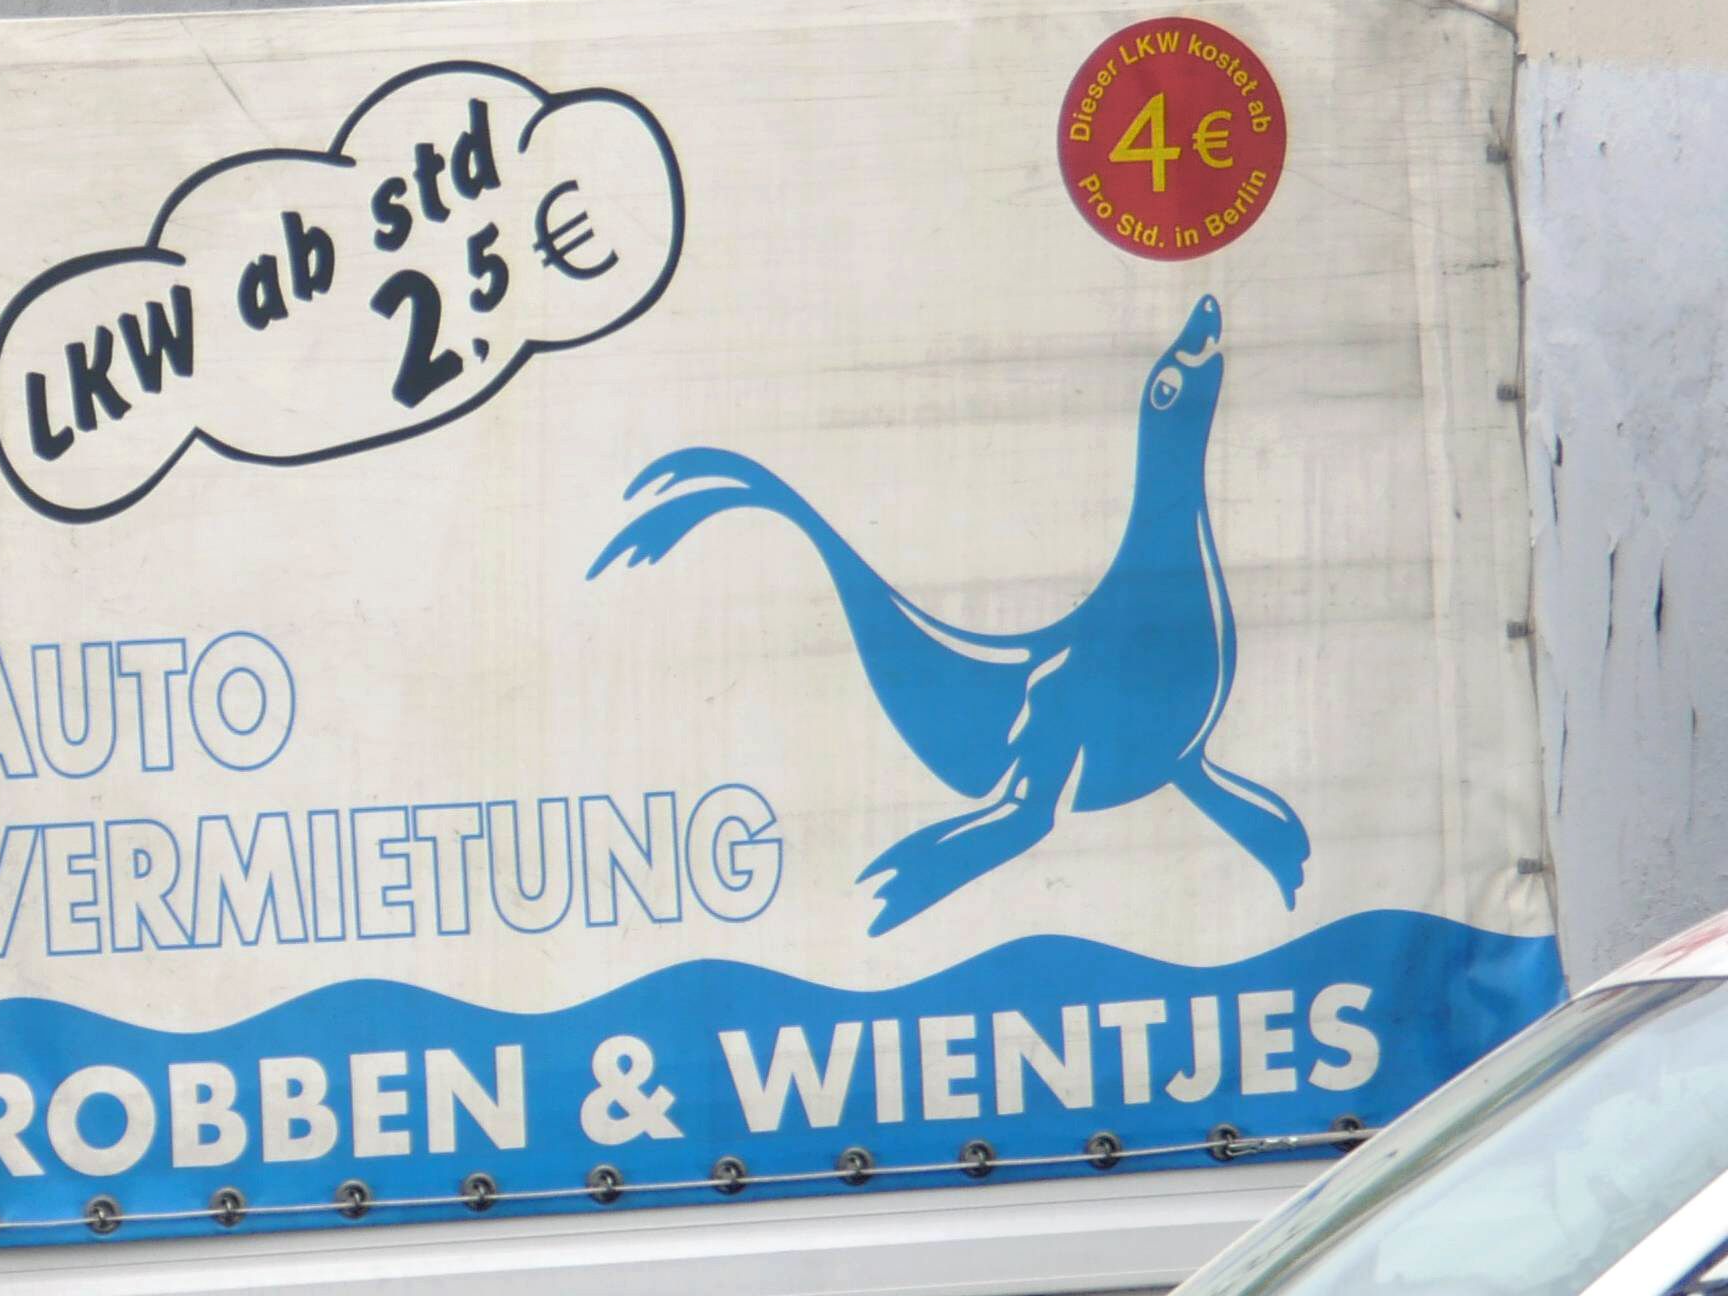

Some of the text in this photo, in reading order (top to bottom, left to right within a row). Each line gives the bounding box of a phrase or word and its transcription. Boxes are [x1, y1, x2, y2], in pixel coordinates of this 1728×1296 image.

[1069, 31, 1272, 142] Dieser LKW kostet ab
[1108, 92, 1181, 192] 4
[1078, 169, 1267, 248] Pro Std. in Berlin
[25, 98, 501, 461] LKW ab std
[580, 1034, 686, 1146] &
[717, 982, 1381, 1134] WIENTJES
